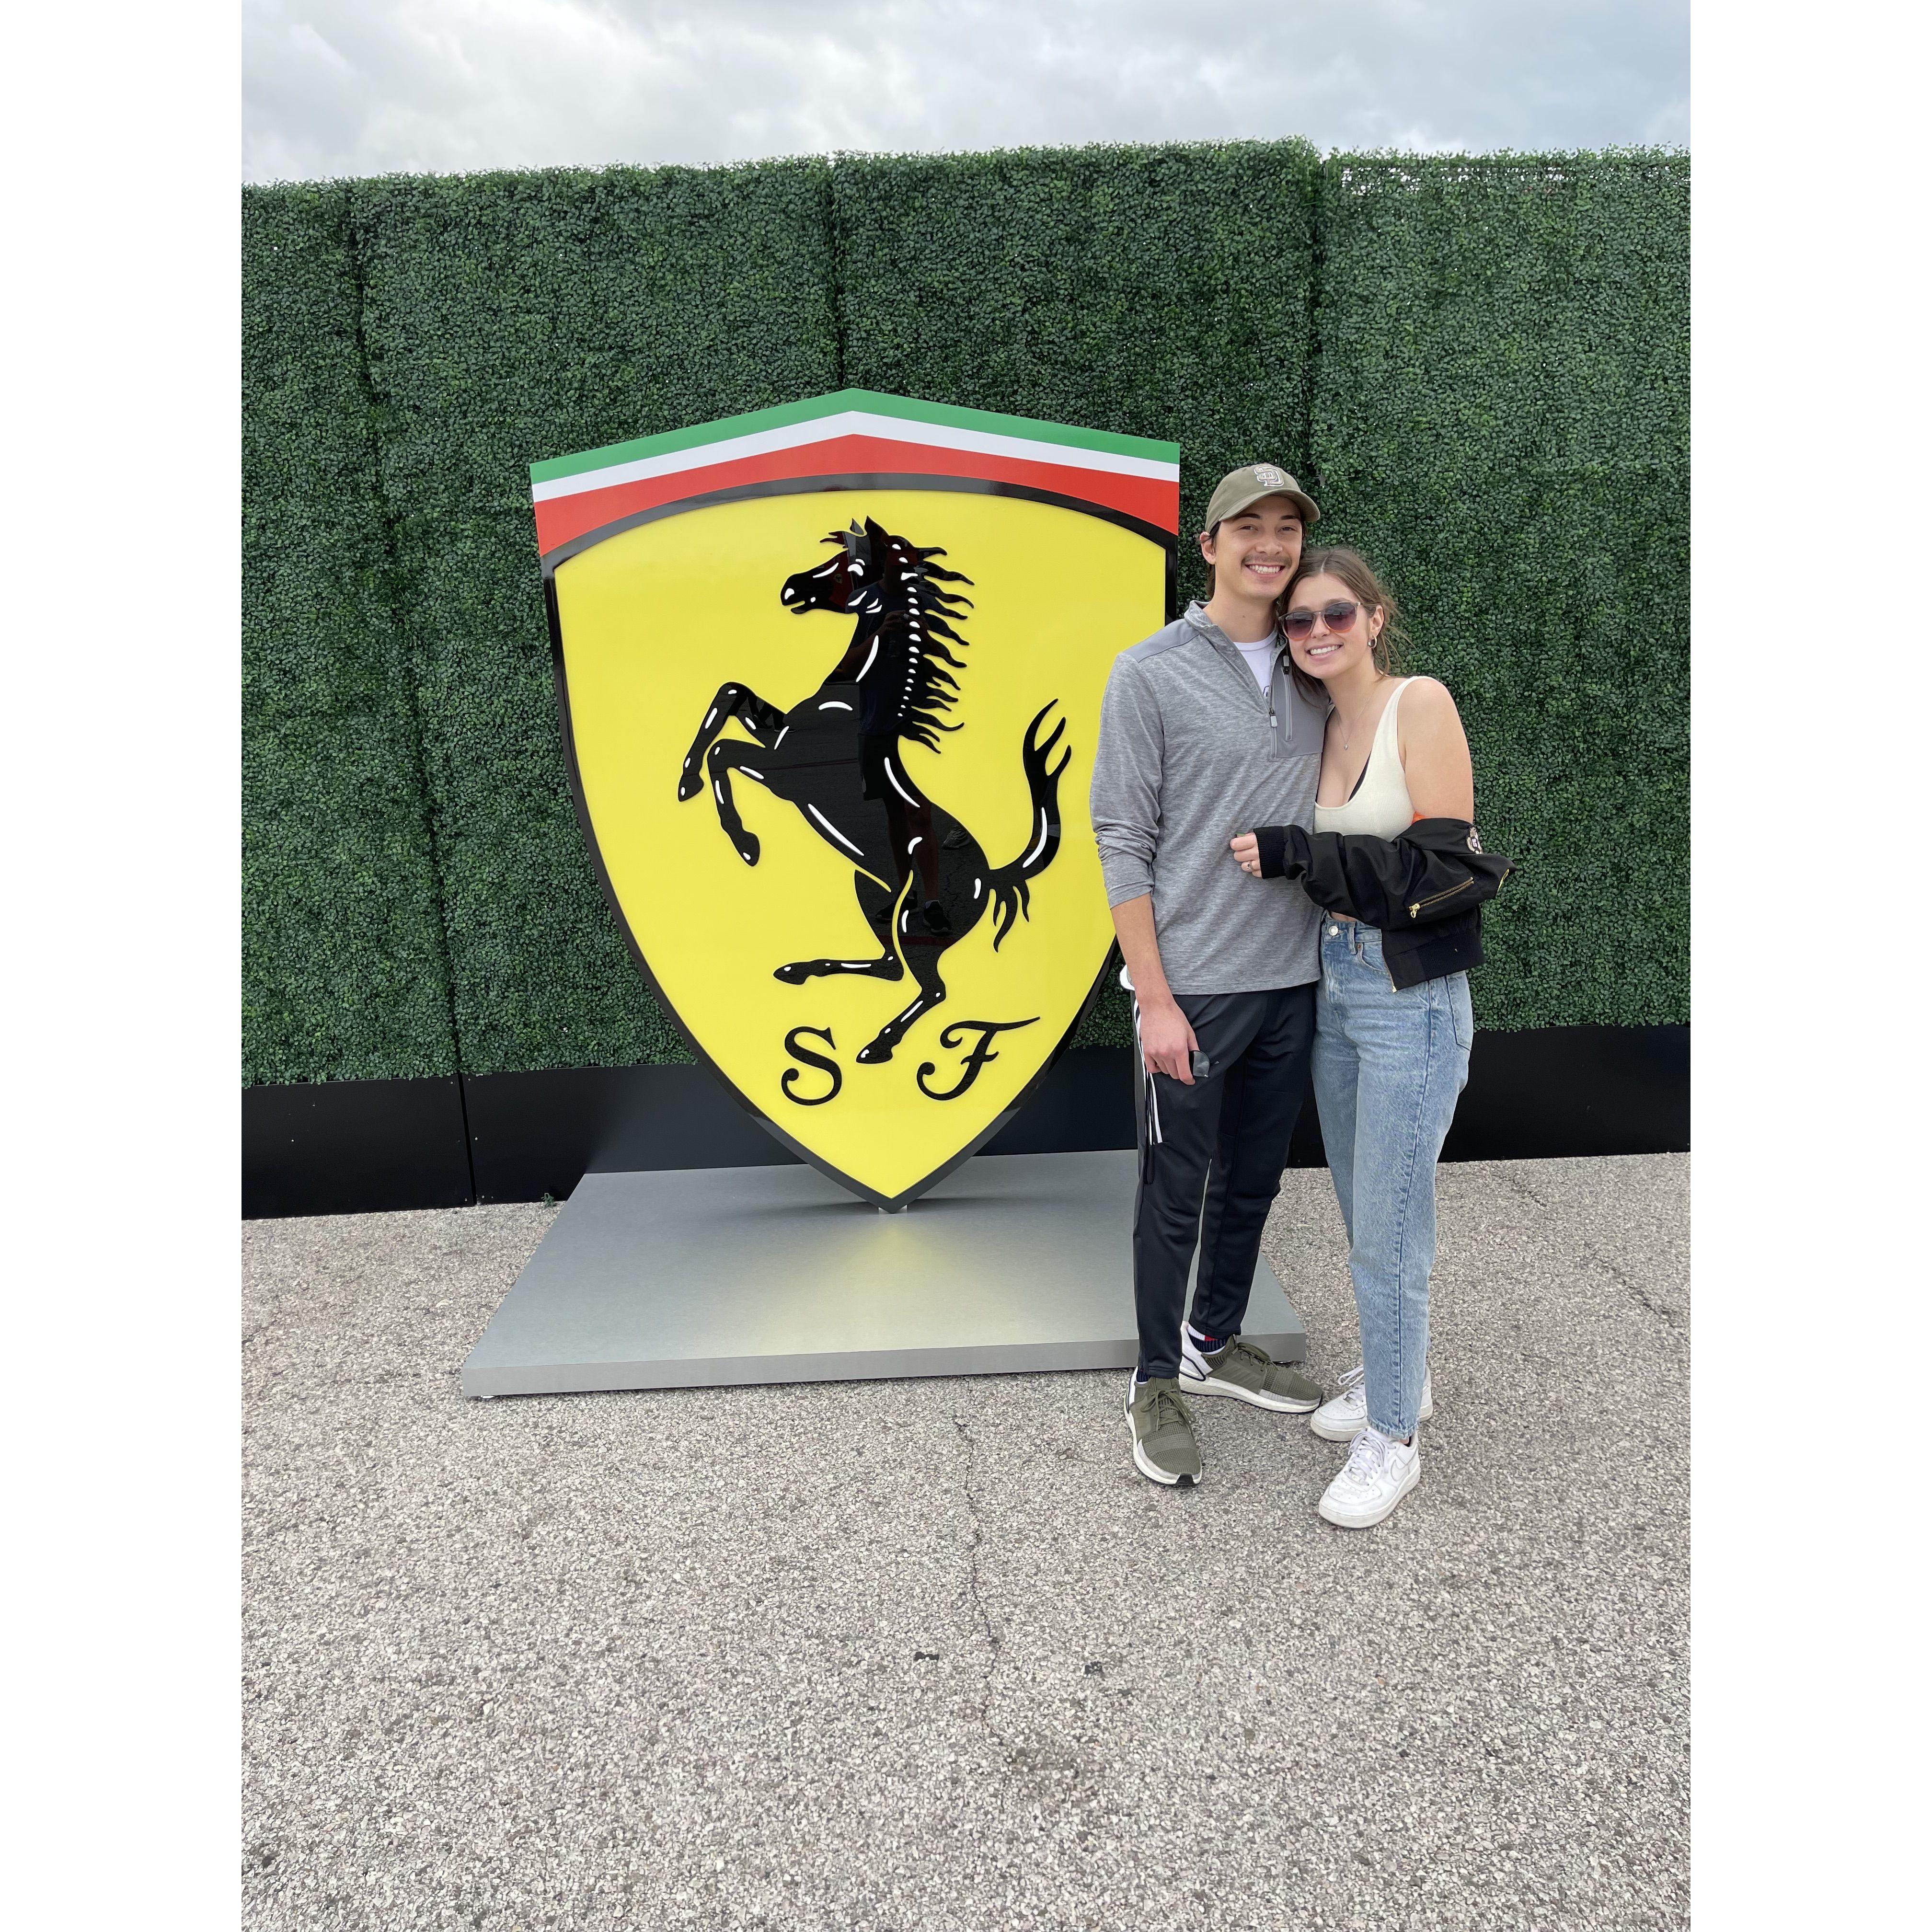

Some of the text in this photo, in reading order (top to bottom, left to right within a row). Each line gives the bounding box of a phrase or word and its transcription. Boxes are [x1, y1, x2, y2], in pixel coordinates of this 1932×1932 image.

[1254, 463, 1285, 487] SD
[781, 1016, 1041, 1106] S F
